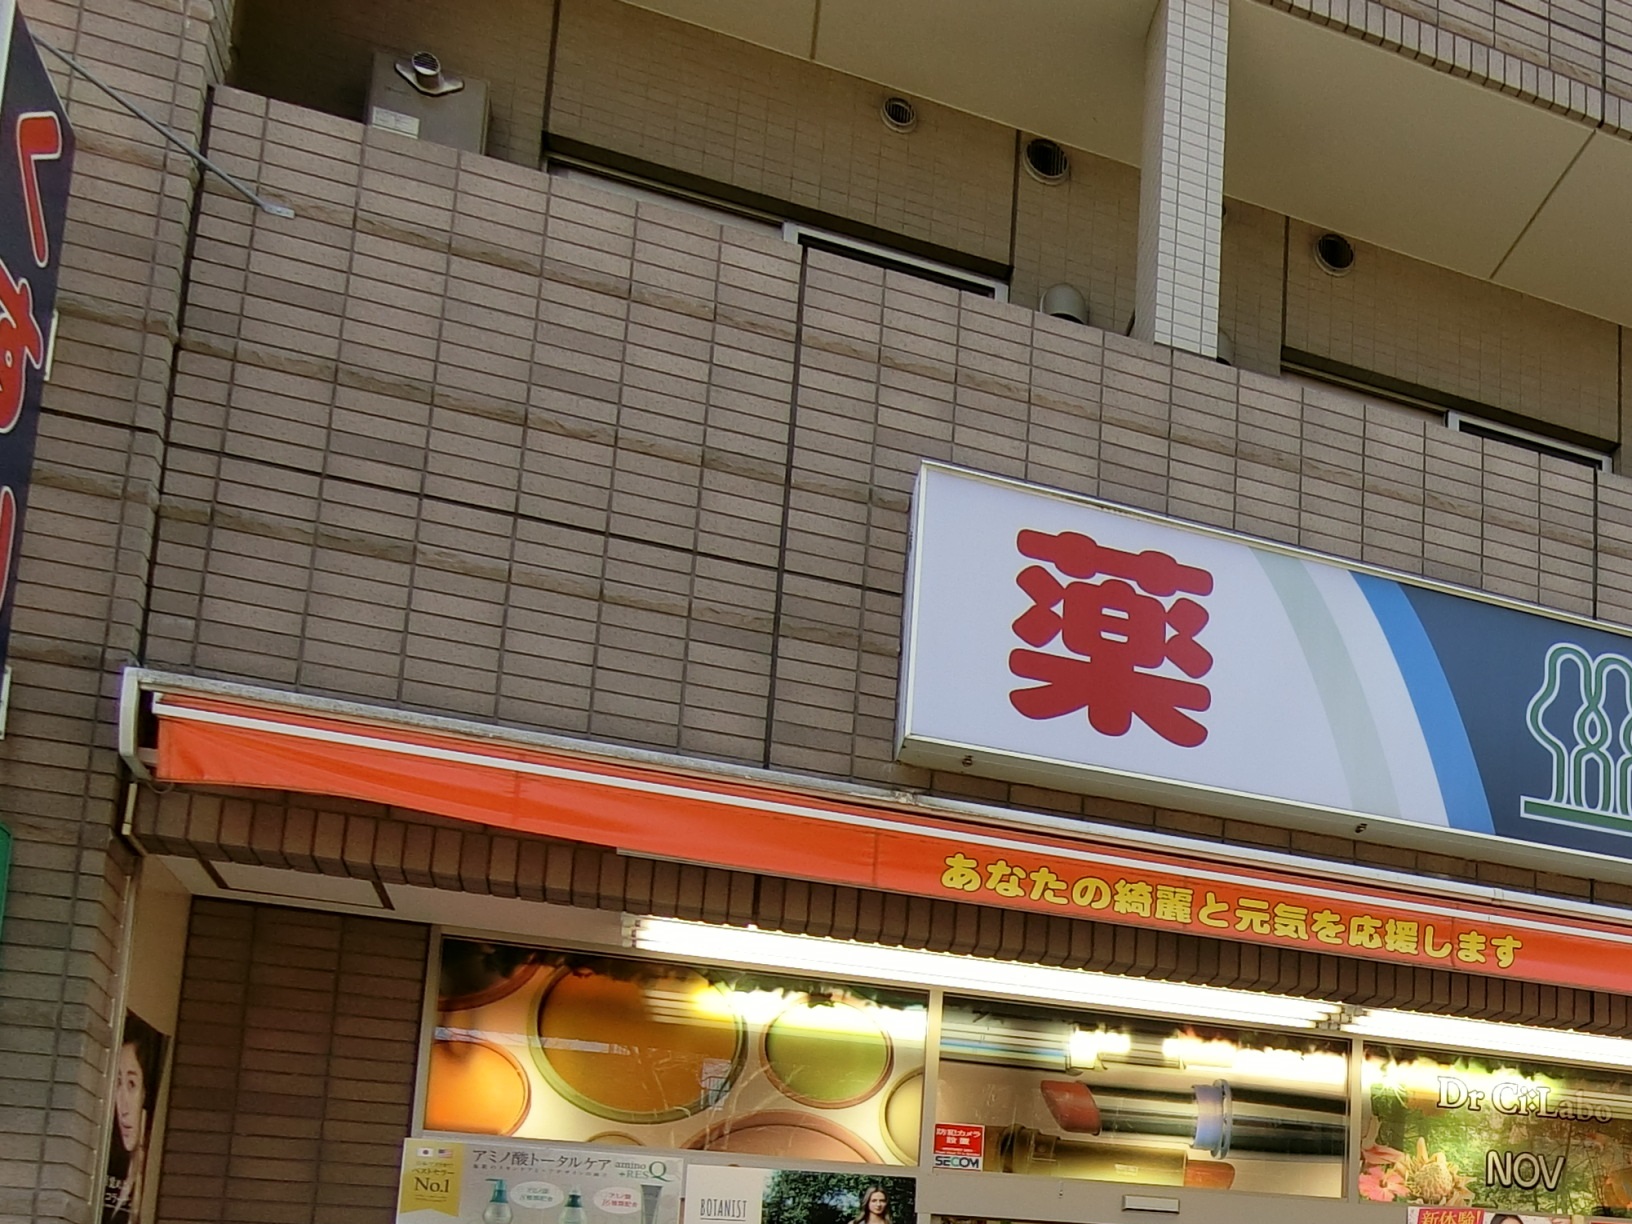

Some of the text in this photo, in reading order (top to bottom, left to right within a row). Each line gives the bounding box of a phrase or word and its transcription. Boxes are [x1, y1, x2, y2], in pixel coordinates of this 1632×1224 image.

[1008, 528, 1214, 748] 薬
[940, 852, 1523, 969] あなたの綺麗と元気を応援します
[473, 1150, 611, 1170] アミノ酸トータルケア
[615, 1161, 646, 1171] amino
[935, 1156, 979, 1168] SECOM
[1486, 1150, 1565, 1191] NOV
[414, 1176, 450, 1194] No.1
[700, 1198, 747, 1218] BOTANIST
